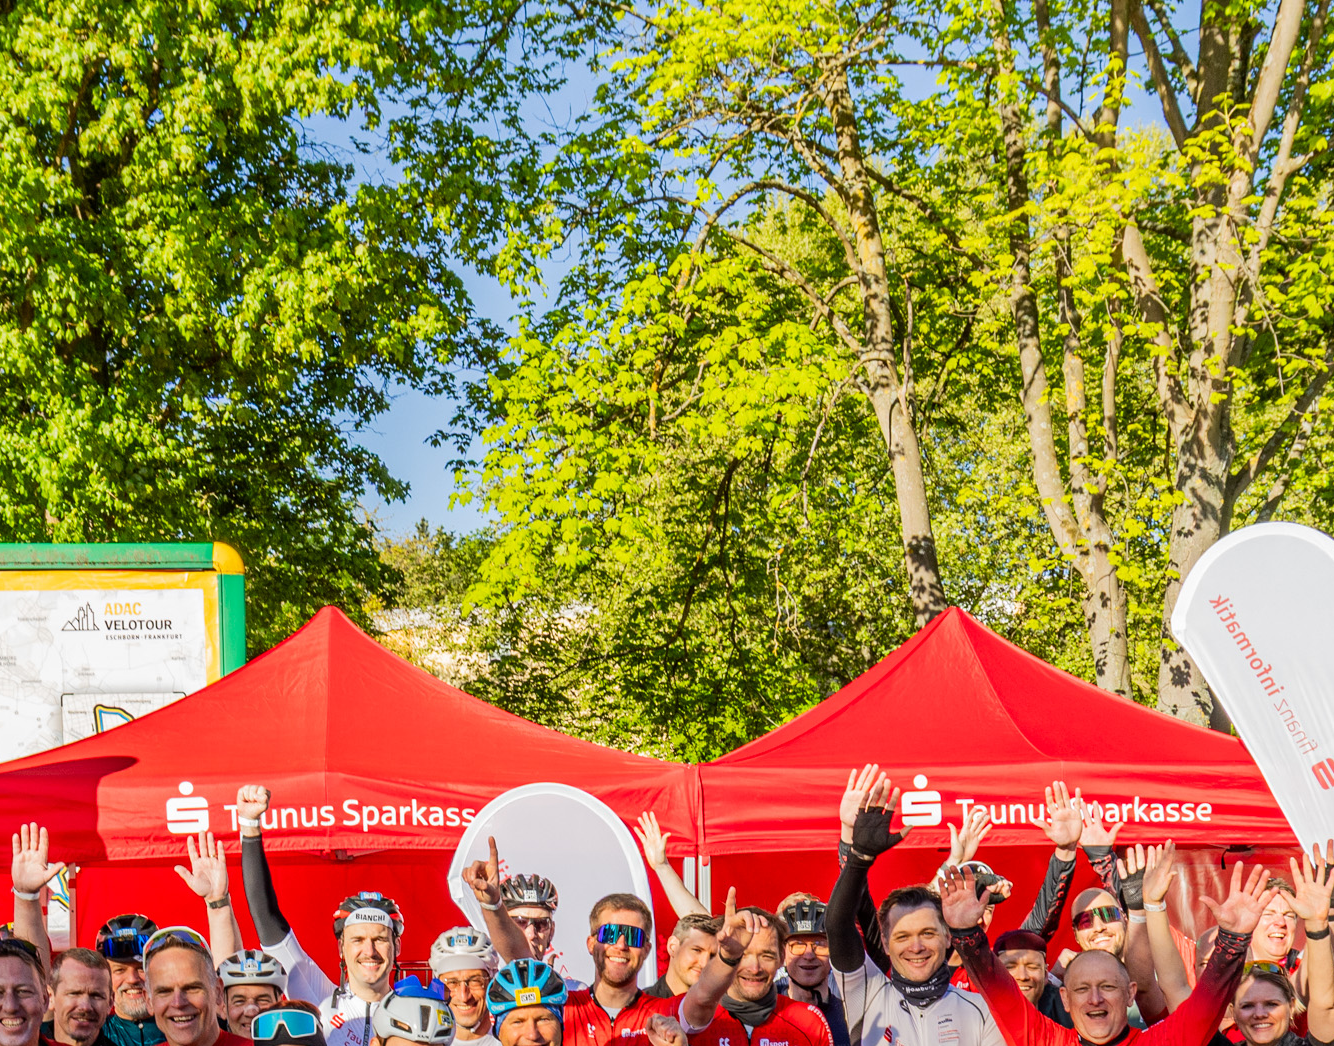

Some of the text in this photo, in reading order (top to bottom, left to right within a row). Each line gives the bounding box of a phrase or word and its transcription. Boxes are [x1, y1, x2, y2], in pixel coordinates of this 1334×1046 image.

[104, 602, 142, 615] ADAC
[105, 619, 172, 631] VELOTOUR
[224, 798, 475, 831] Tunus Sparkass
[355, 913, 385, 921] BIANCHI
